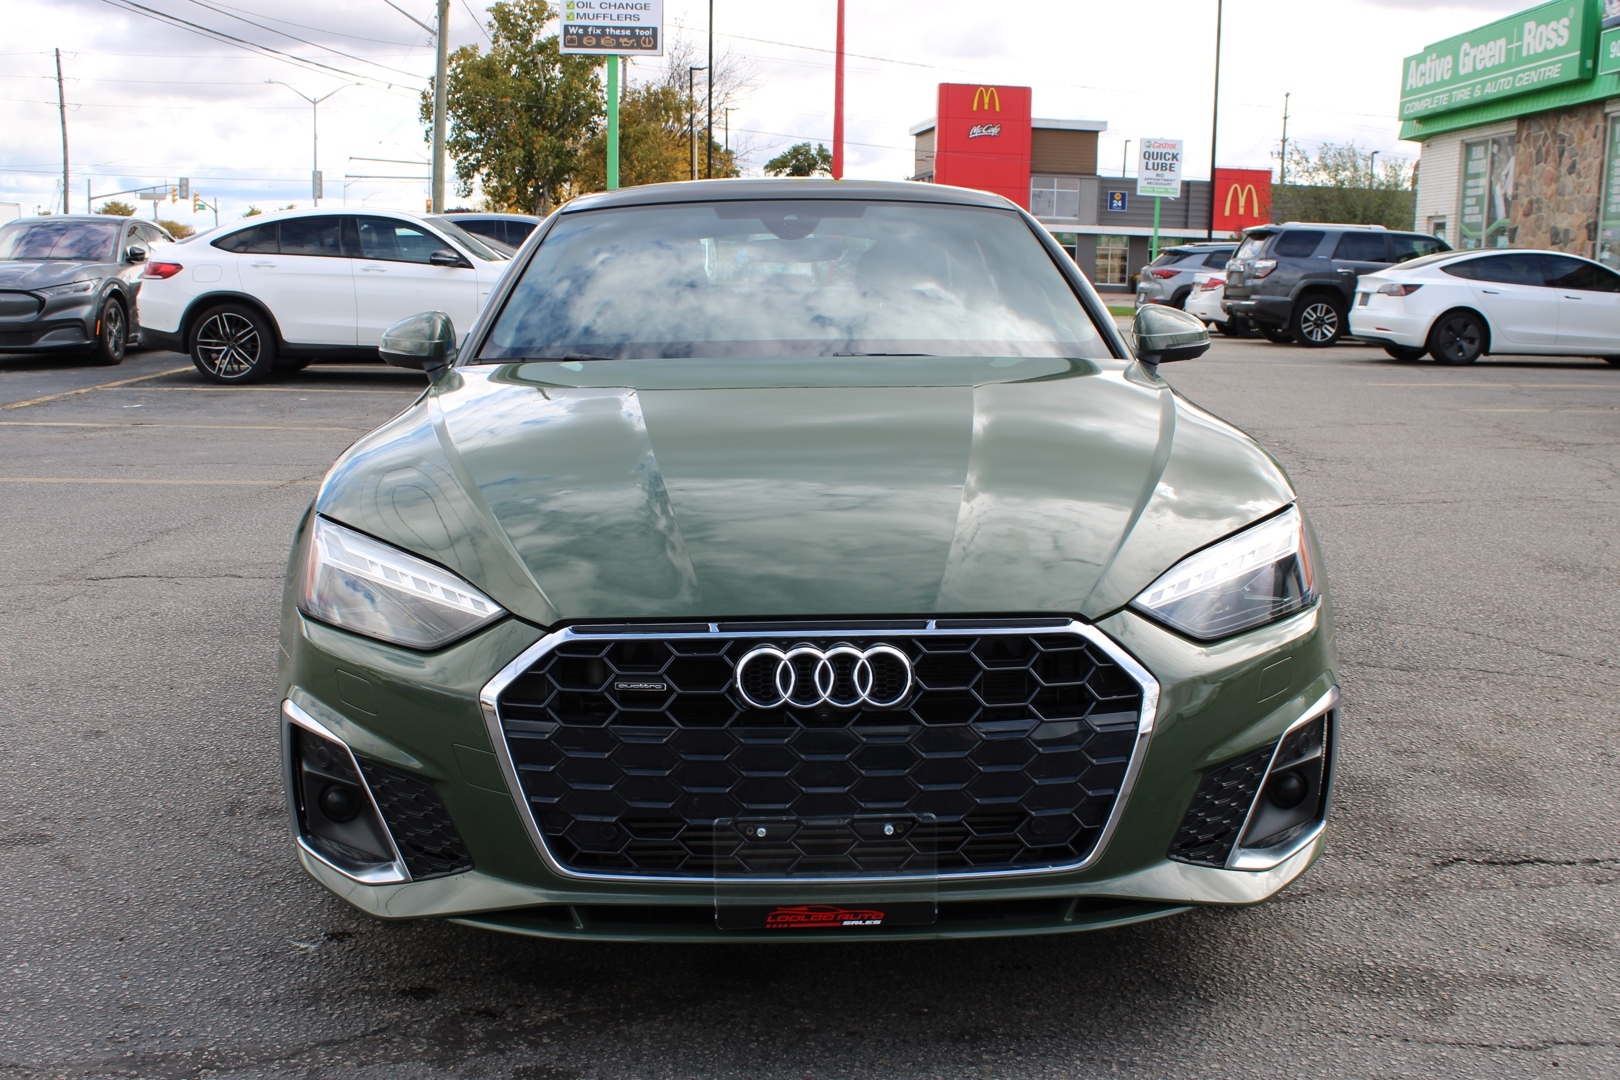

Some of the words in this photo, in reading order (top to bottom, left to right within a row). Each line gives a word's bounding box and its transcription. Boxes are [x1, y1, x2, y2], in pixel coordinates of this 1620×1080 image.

[576, 1, 595, 9] OIL
[600, 2, 651, 10] CHANGE
[576, 12, 640, 21] MUFFLERS
[568, 26, 584, 34] We
[588, 26, 602, 34] fix
[605, 27, 631, 35] these
[1406, 52, 1453, 91] Active
[1458, 37, 1506, 76] Green
[1404, 92, 1450, 115] COMPLETE
[1451, 87, 1472, 103] TIRE
[1473, 84, 1482, 97] &
[1484, 76, 1513, 95] AUTO
[1515, 63, 1563, 87] CENTRE
[1152, 141, 1177, 150] Castrol
[1143, 151, 1179, 161] QUICK
[1145, 161, 1176, 172] LUBE
